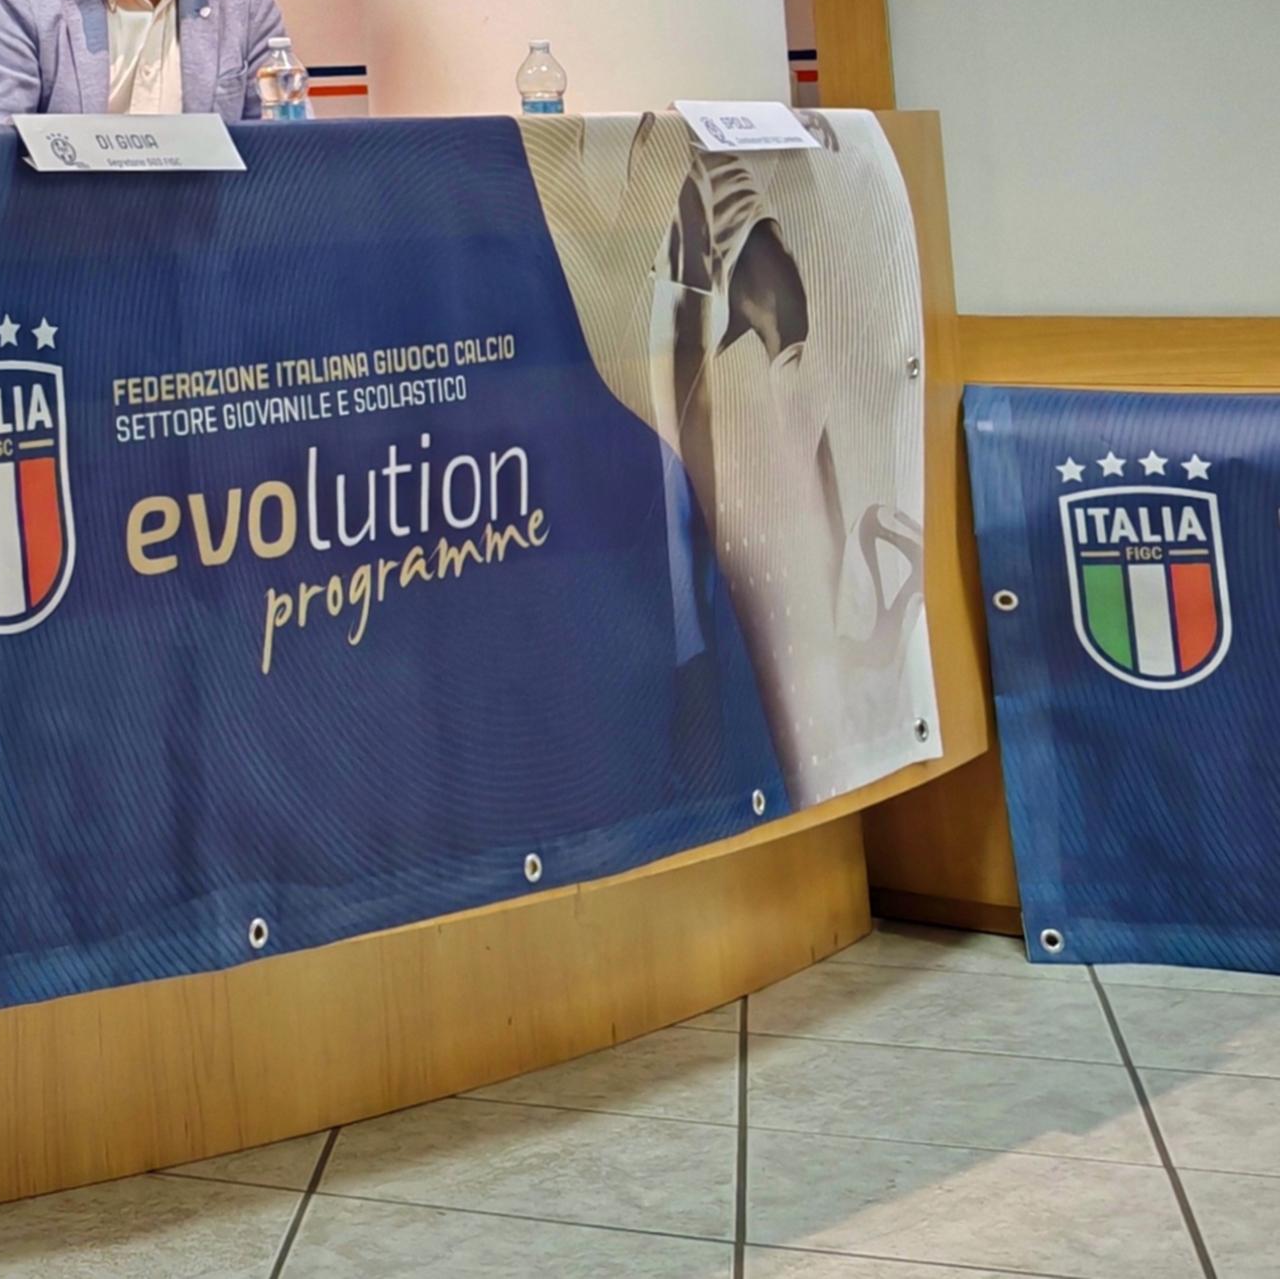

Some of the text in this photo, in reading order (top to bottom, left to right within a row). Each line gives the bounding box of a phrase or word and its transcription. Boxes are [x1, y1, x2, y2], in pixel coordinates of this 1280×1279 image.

[95, 133, 159, 150] DI GIOIA
[113, 334, 516, 406] FEDERAZIONE ITALIANA GIUOCO CALCIO
[115, 374, 467, 443] SETTORE GIOVANILE E SCOLASTICO
[125, 432, 529, 576] evolution
[1074, 505, 1207, 544] ITALIA
[1125, 546, 1163, 561] FIGC
[260, 507, 550, 675] programme
